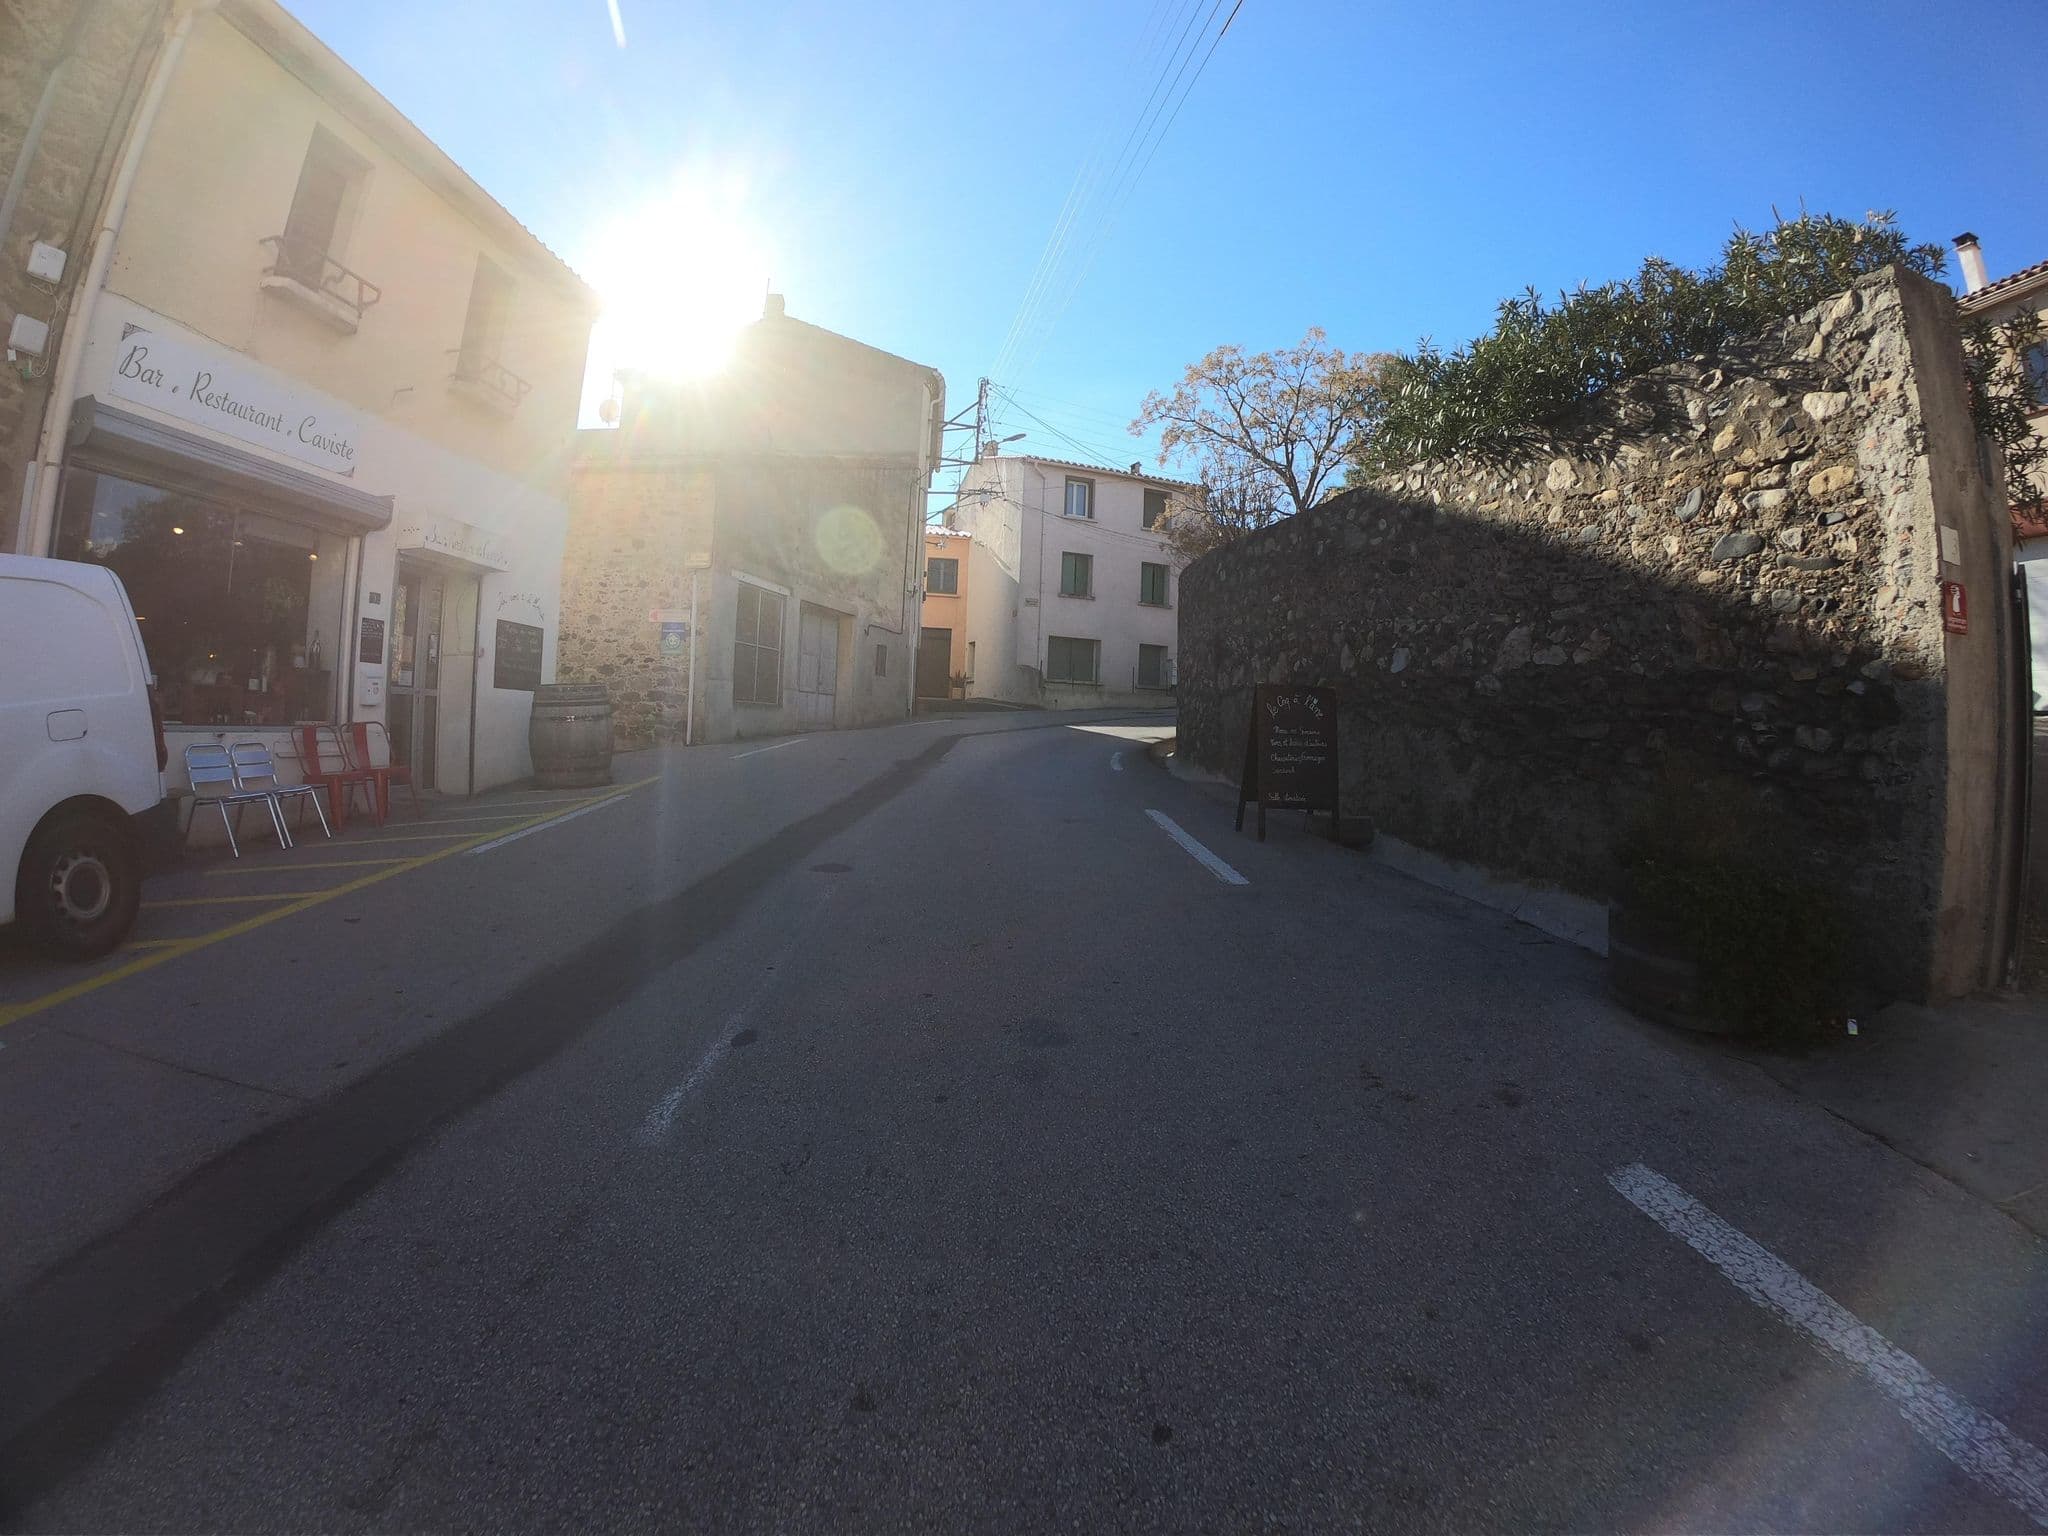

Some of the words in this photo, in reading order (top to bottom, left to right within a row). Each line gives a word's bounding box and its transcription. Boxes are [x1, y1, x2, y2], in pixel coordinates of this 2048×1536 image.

[118, 344, 164, 389] Bar
[190, 371, 284, 433] Restaurant
[298, 415, 355, 461] Caviste
